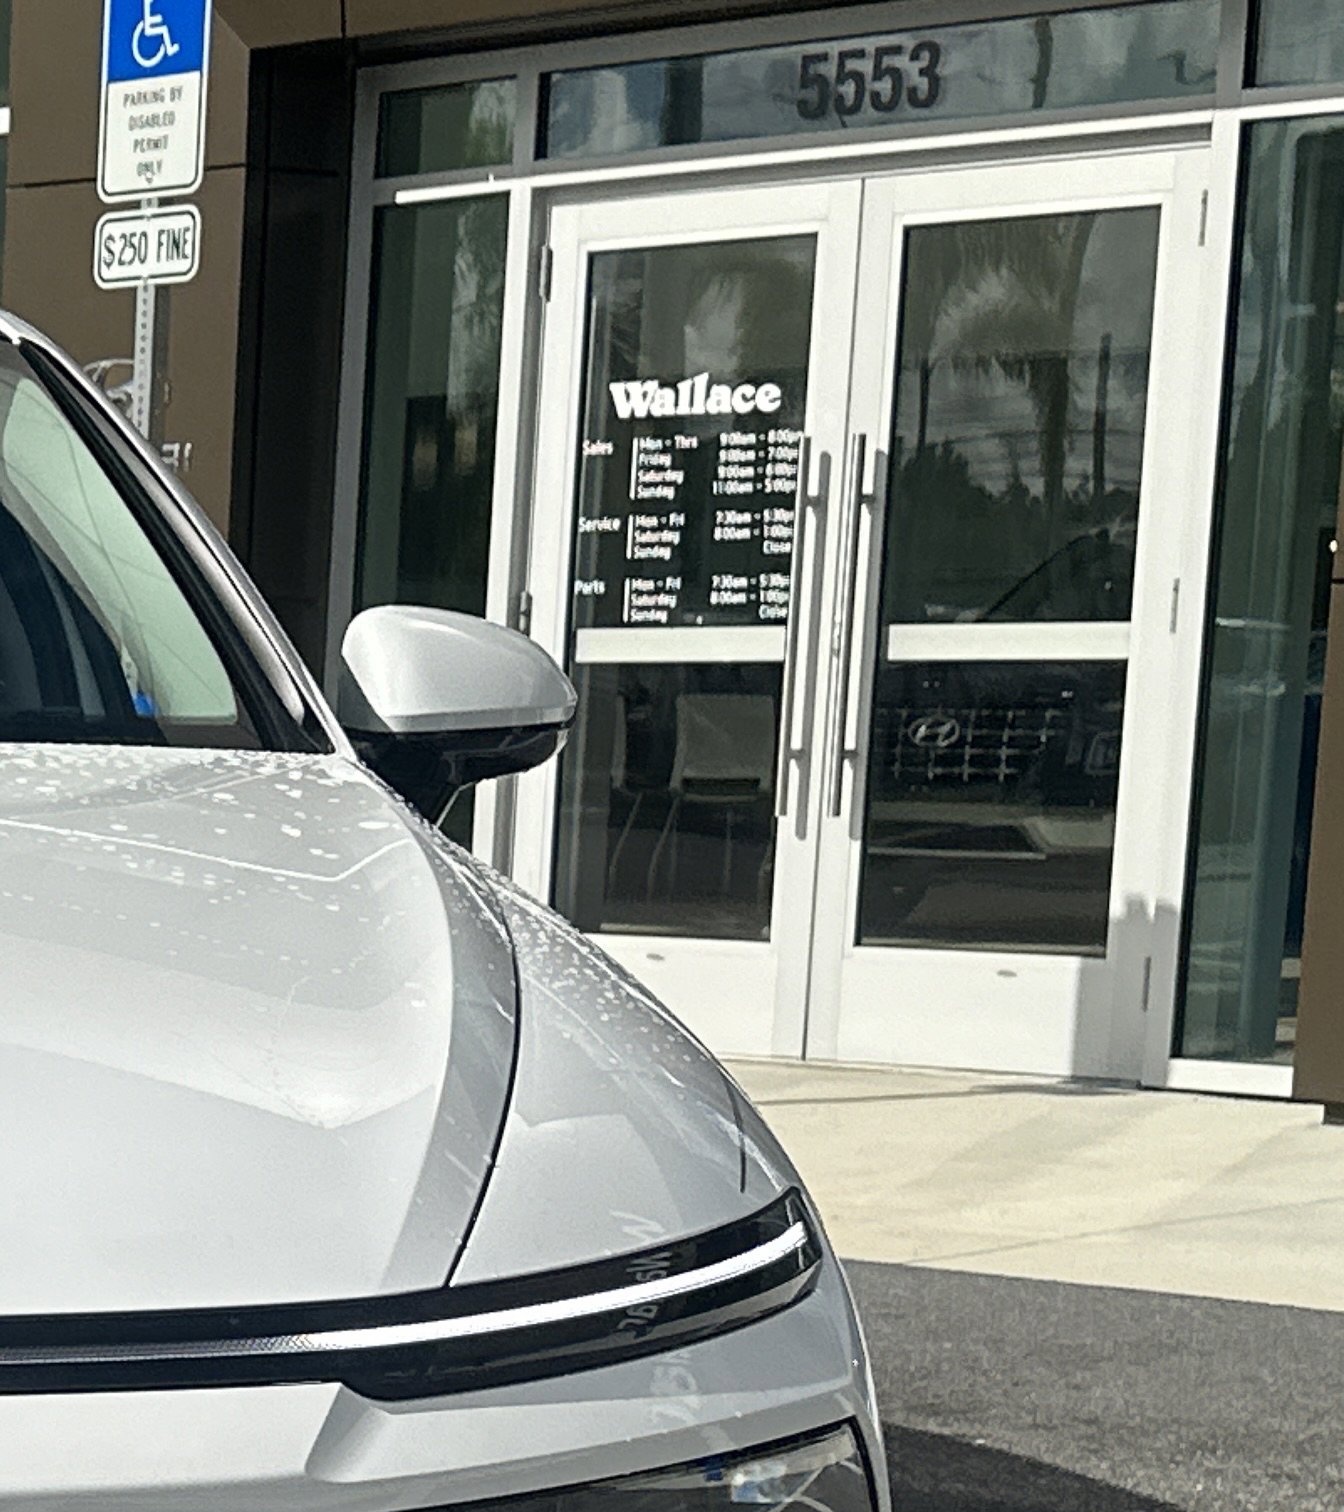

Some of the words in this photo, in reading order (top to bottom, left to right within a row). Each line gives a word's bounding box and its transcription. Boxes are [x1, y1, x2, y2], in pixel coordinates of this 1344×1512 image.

[796, 40, 941, 120] 5553
[103, 231, 149, 270] $250
[156, 227, 191, 263] FINE
[609, 372, 782, 419] Wallace
[578, 516, 621, 532] Service
[574, 580, 605, 595] Parts
